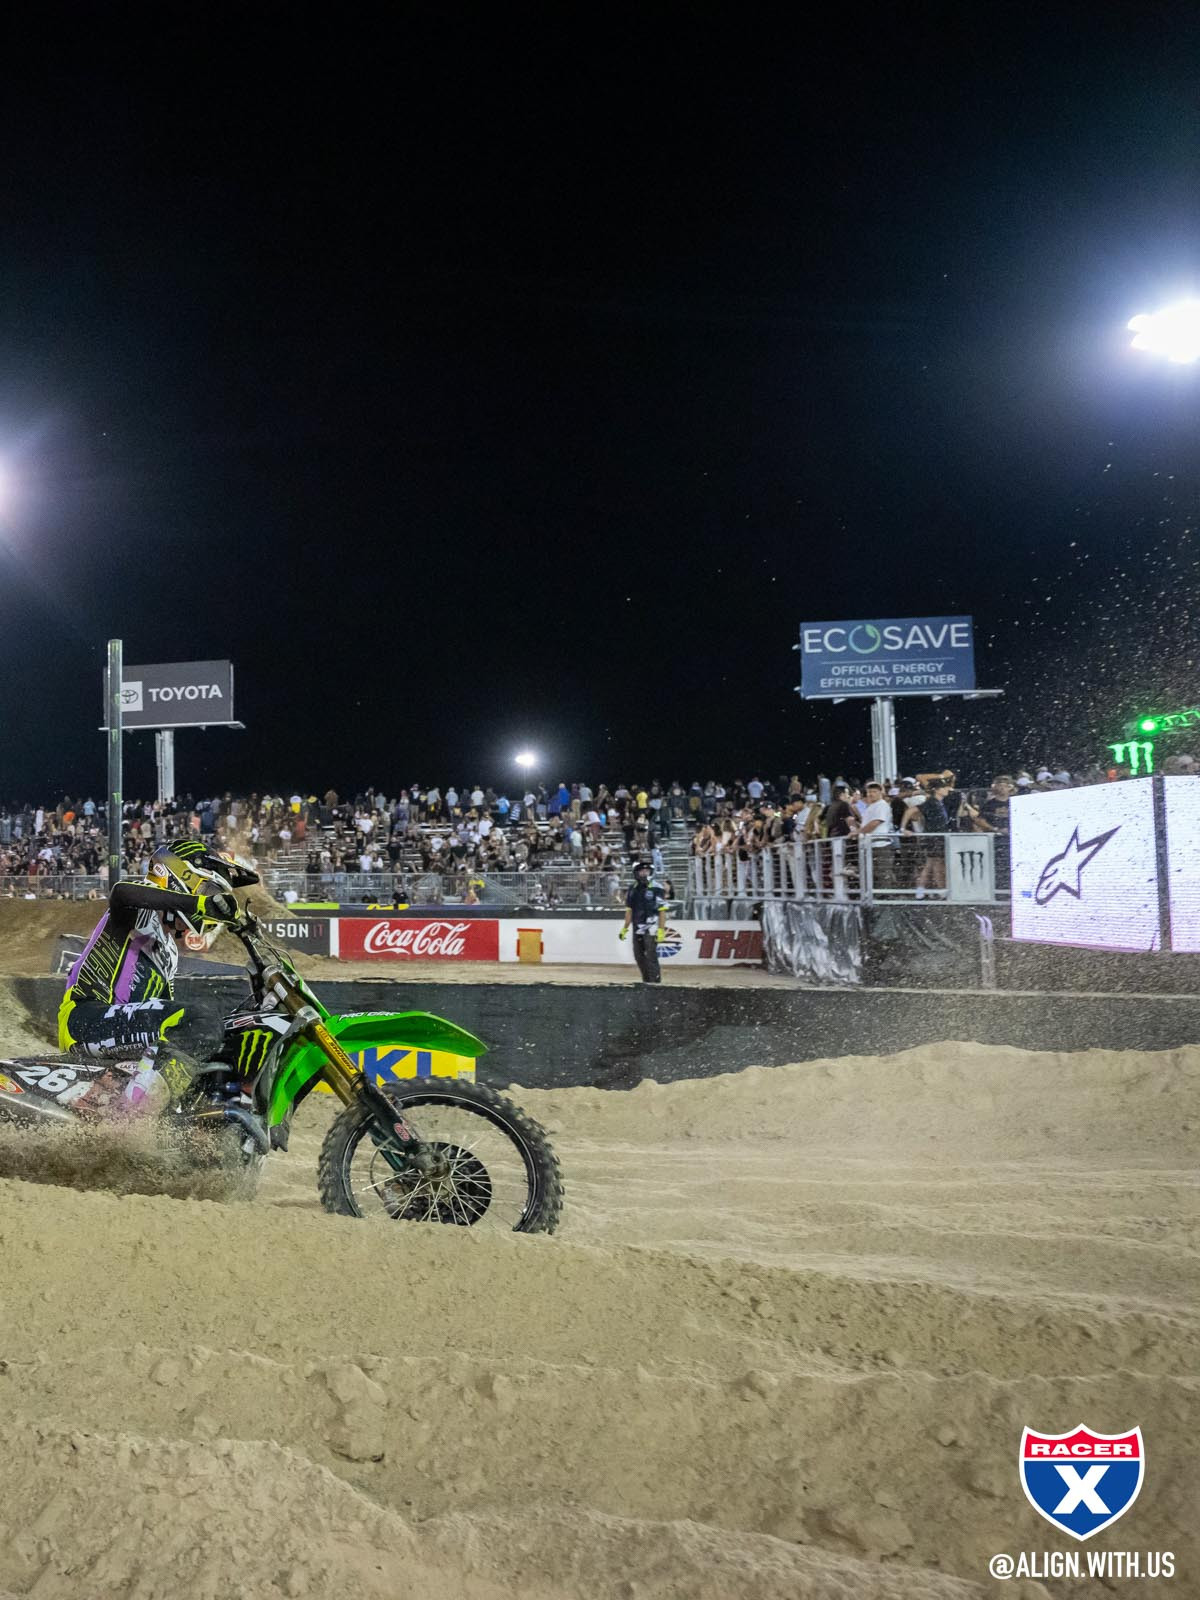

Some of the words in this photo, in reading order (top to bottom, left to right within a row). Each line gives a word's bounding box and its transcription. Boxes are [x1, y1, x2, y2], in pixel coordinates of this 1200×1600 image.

[803, 623, 969, 654] ECOSAVE
[831, 664, 888, 676] OFFICIAL
[892, 662, 944, 674] ENERGY
[820, 676, 891, 688] EFFICIENCY
[896, 674, 956, 685] PARTNER
[148, 684, 223, 702] TOYOTA
[364, 921, 471, 956] Coca-Cola
